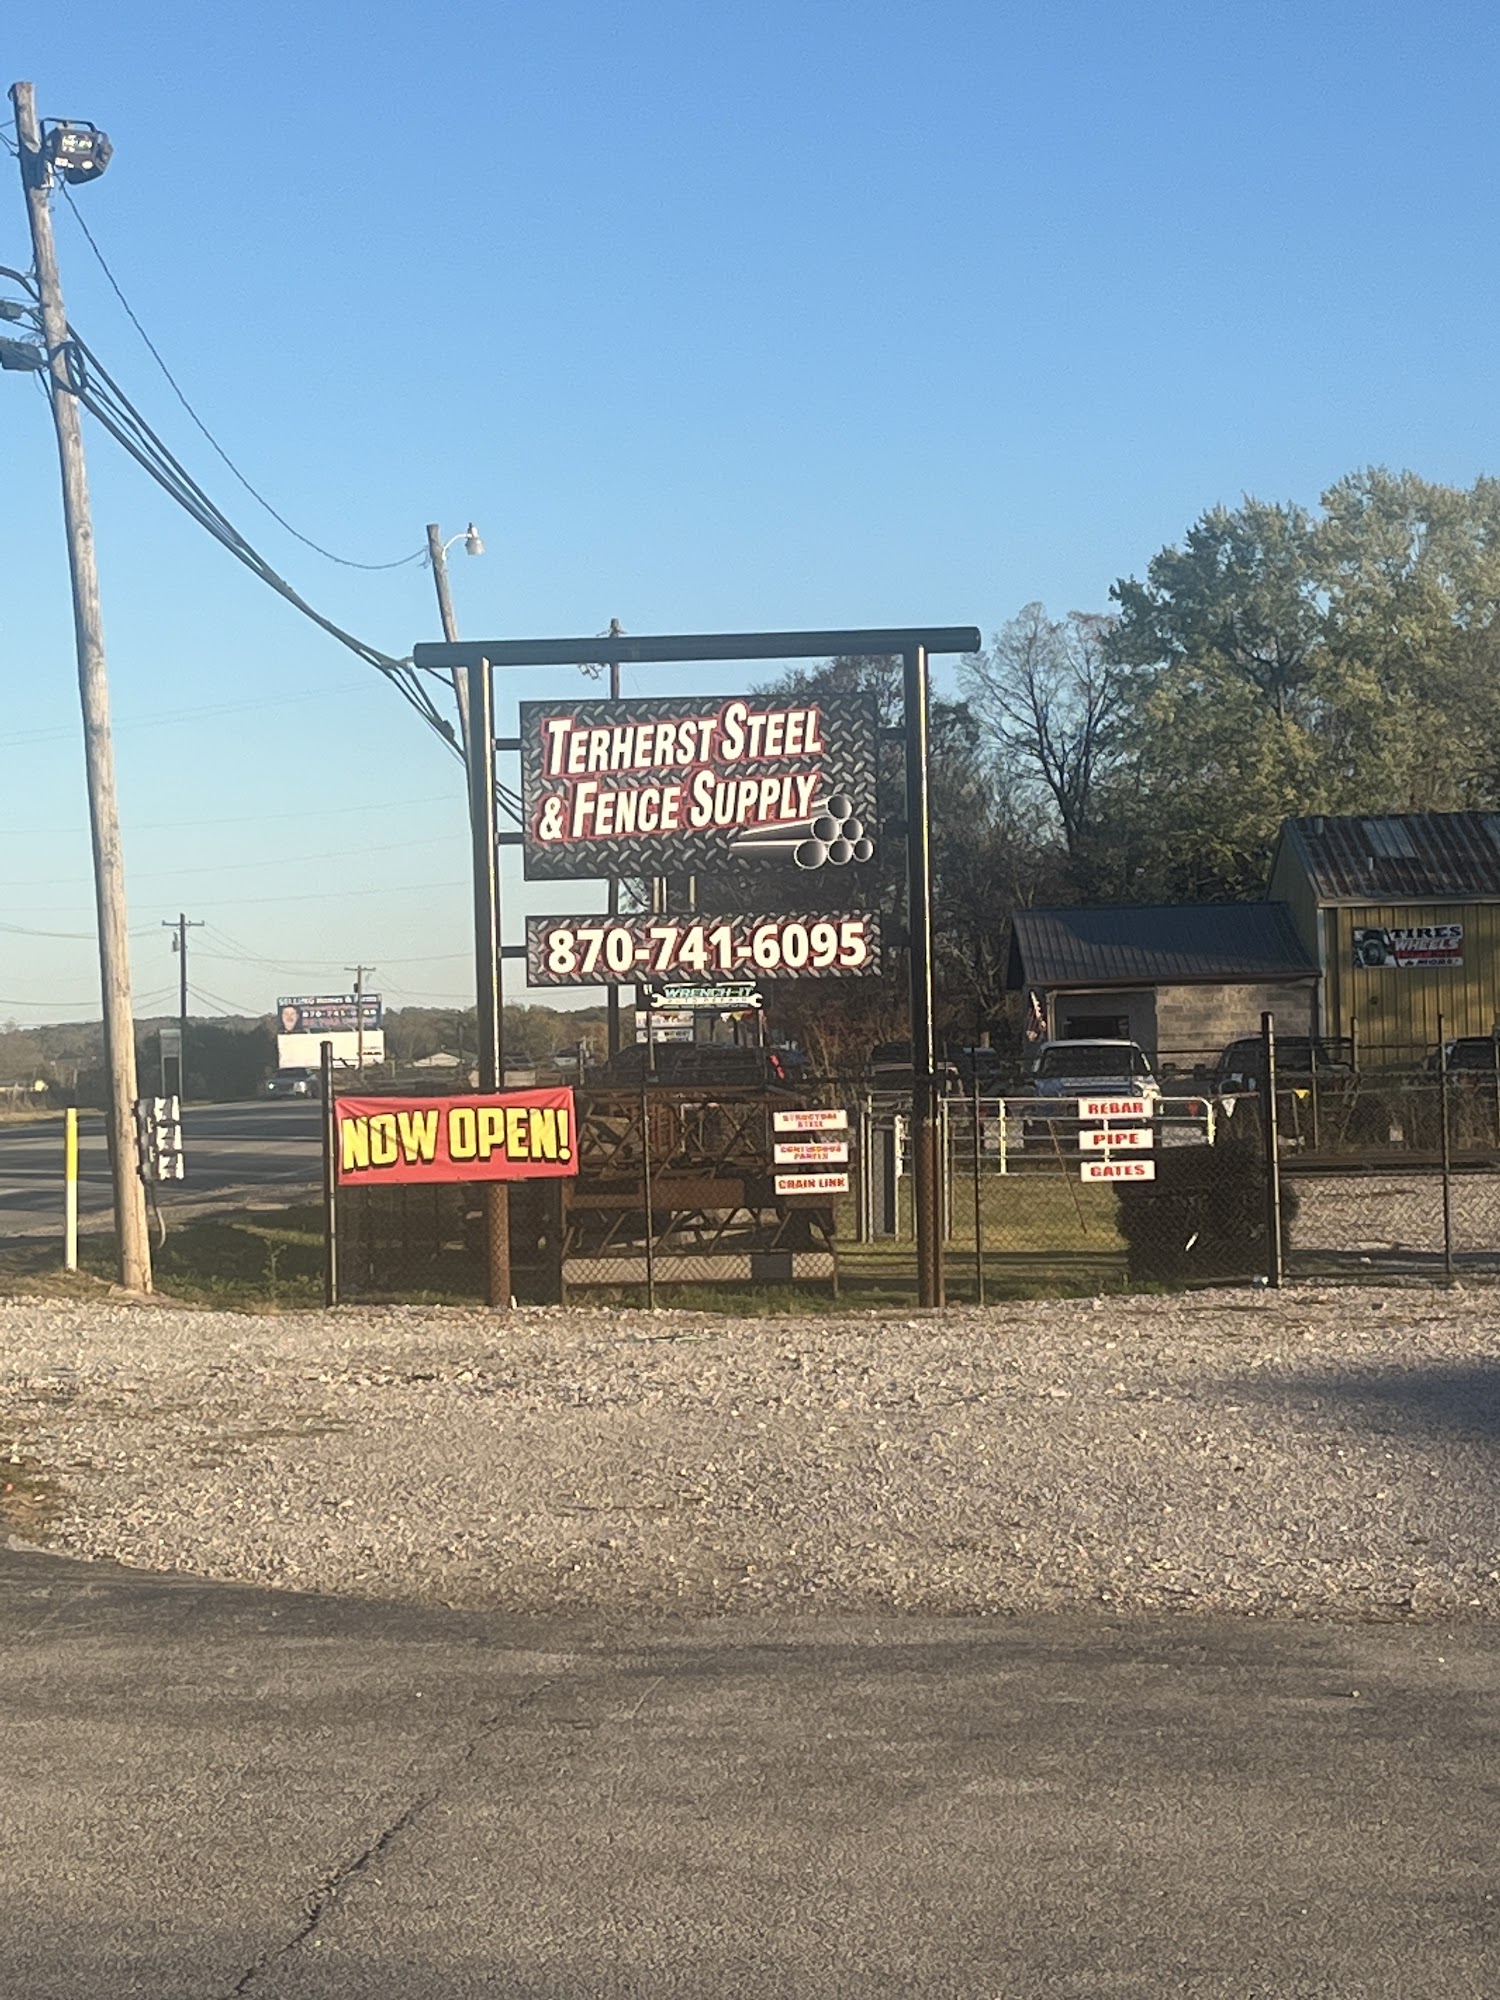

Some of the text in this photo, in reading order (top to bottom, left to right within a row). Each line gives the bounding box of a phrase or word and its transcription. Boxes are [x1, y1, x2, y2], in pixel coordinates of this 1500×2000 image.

[547, 702, 822, 776] TERHERST STEEL
[538, 769, 817, 840] & FENCE SUPPLY
[1391, 926, 1461, 939] TIRES
[548, 923, 867, 973] 870-741-6095
[1395, 940, 1459, 951] WHEELS
[1088, 1102, 1144, 1114] REBAR
[342, 1107, 571, 1171] NOW OPEN!
[1093, 1133, 1139, 1145] PIPE
[1090, 1165, 1146, 1177] GATES
[778, 1177, 845, 1189] CHAIN LINK
